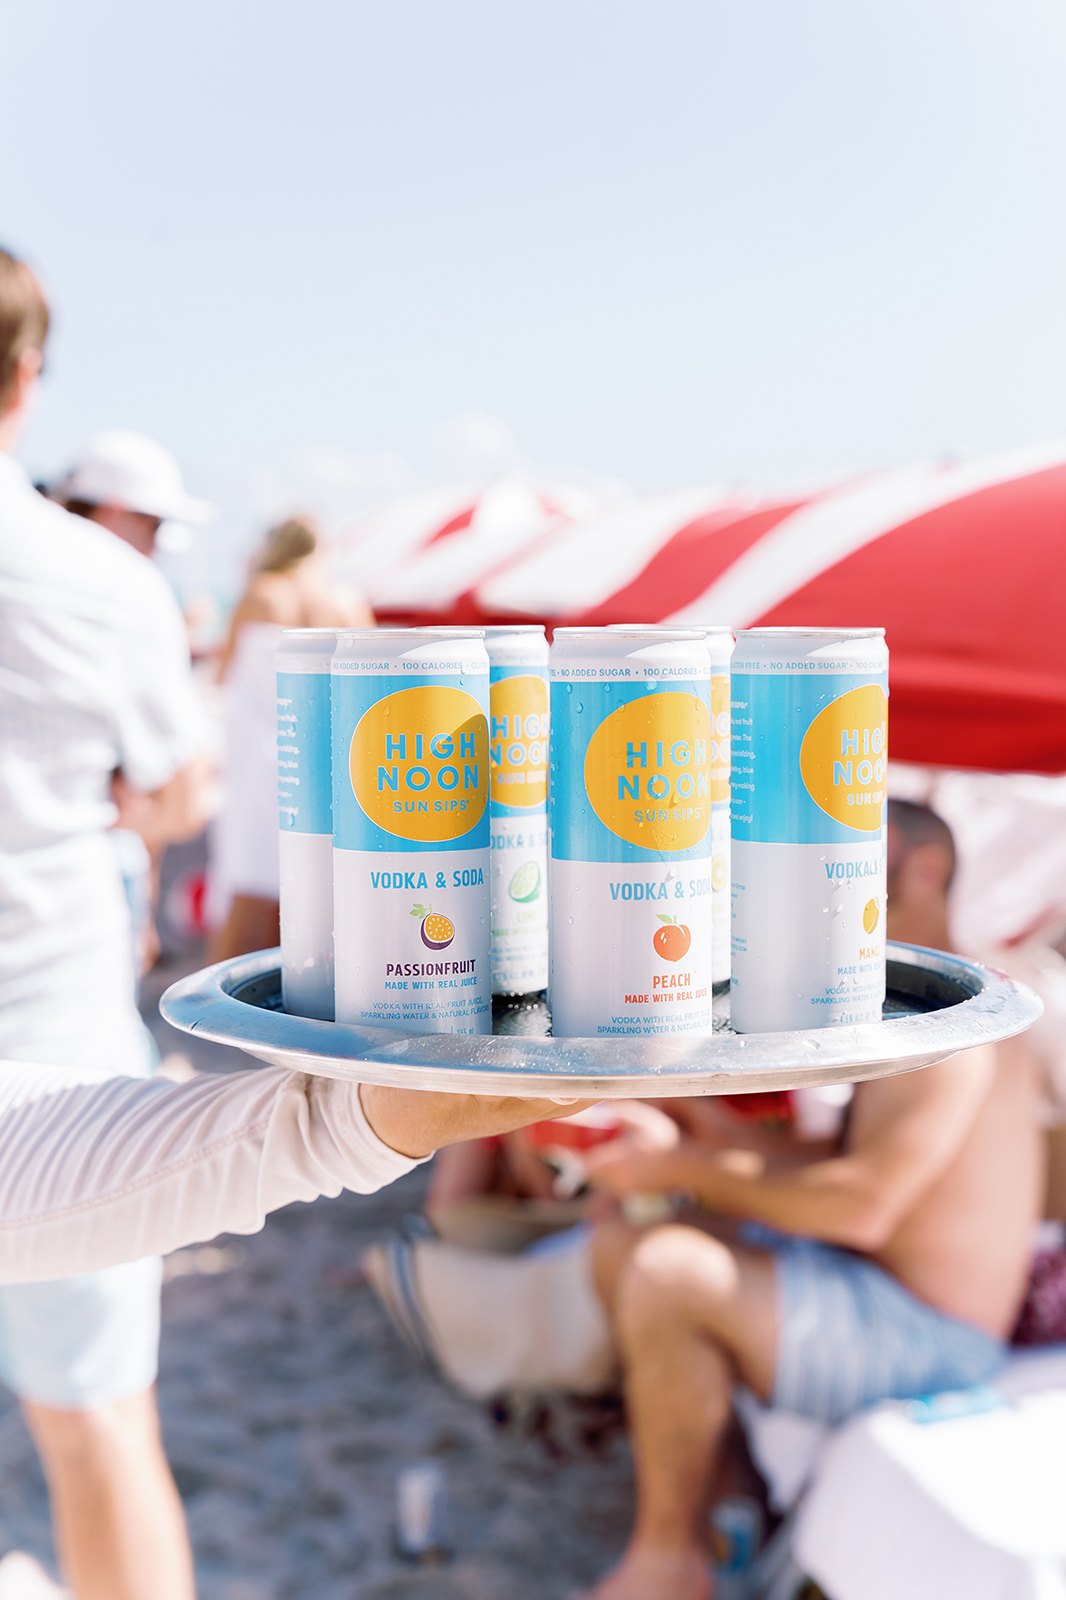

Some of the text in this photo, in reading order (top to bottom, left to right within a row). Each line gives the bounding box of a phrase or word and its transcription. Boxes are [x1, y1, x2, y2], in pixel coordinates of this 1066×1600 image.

[402, 662, 419, 670] 100
[422, 662, 463, 670] CALORIES
[561, 668, 570, 676] NO
[571, 668, 597, 676] ADDED
[599, 668, 631, 677] SUGAR
[643, 668, 660, 676] 100
[662, 667, 698, 676] CALORIES
[770, 662, 783, 670] NO
[785, 662, 816, 670] ADDED
[386, 732, 475, 760] HIGH
[841, 728, 882, 756] HIG
[490, 740, 548, 766] NOO
[626, 739, 706, 768] HIGH
[377, 764, 479, 792] NOON
[833, 758, 882, 786] NOO
[618, 771, 708, 800] NOON
[393, 800, 428, 813] SUN
[847, 792, 871, 806] SUN
[634, 809, 668, 822] SUN
[490, 834, 524, 850] ODKA
[825, 862, 870, 879] VODKA
[370, 868, 484, 889] VODKA & SODA
[609, 882, 668, 900] VODKA
[674, 881, 684, 898] &
[386, 959, 476, 976] PASSIONFRUIT
[838, 966, 856, 975] MADE
[385, 977, 477, 990] MADE WITH REAL JUICE
[652, 973, 691, 989] PEACH
[625, 988, 707, 1003] MADE WITH REAL JUICE
[825, 987, 850, 995] VODKA
[372, 1002, 400, 1010] VODKA
[402, 1002, 423, 1010] WITH
[448, 999, 466, 1008] FRUIT
[360, 1011, 400, 1020] SPARKLING
[402, 1012, 430, 1020] WATER
[438, 1009, 470, 1018] NATURAL
[612, 1016, 641, 1024] VODKA
[643, 1016, 664, 1024] WITH
[665, 1015, 683, 1023] REAL
[597, 1026, 642, 1034] SPARKLING
[643, 1026, 669, 1034] WATER
[677, 1022, 702, 1031] NATURAL
